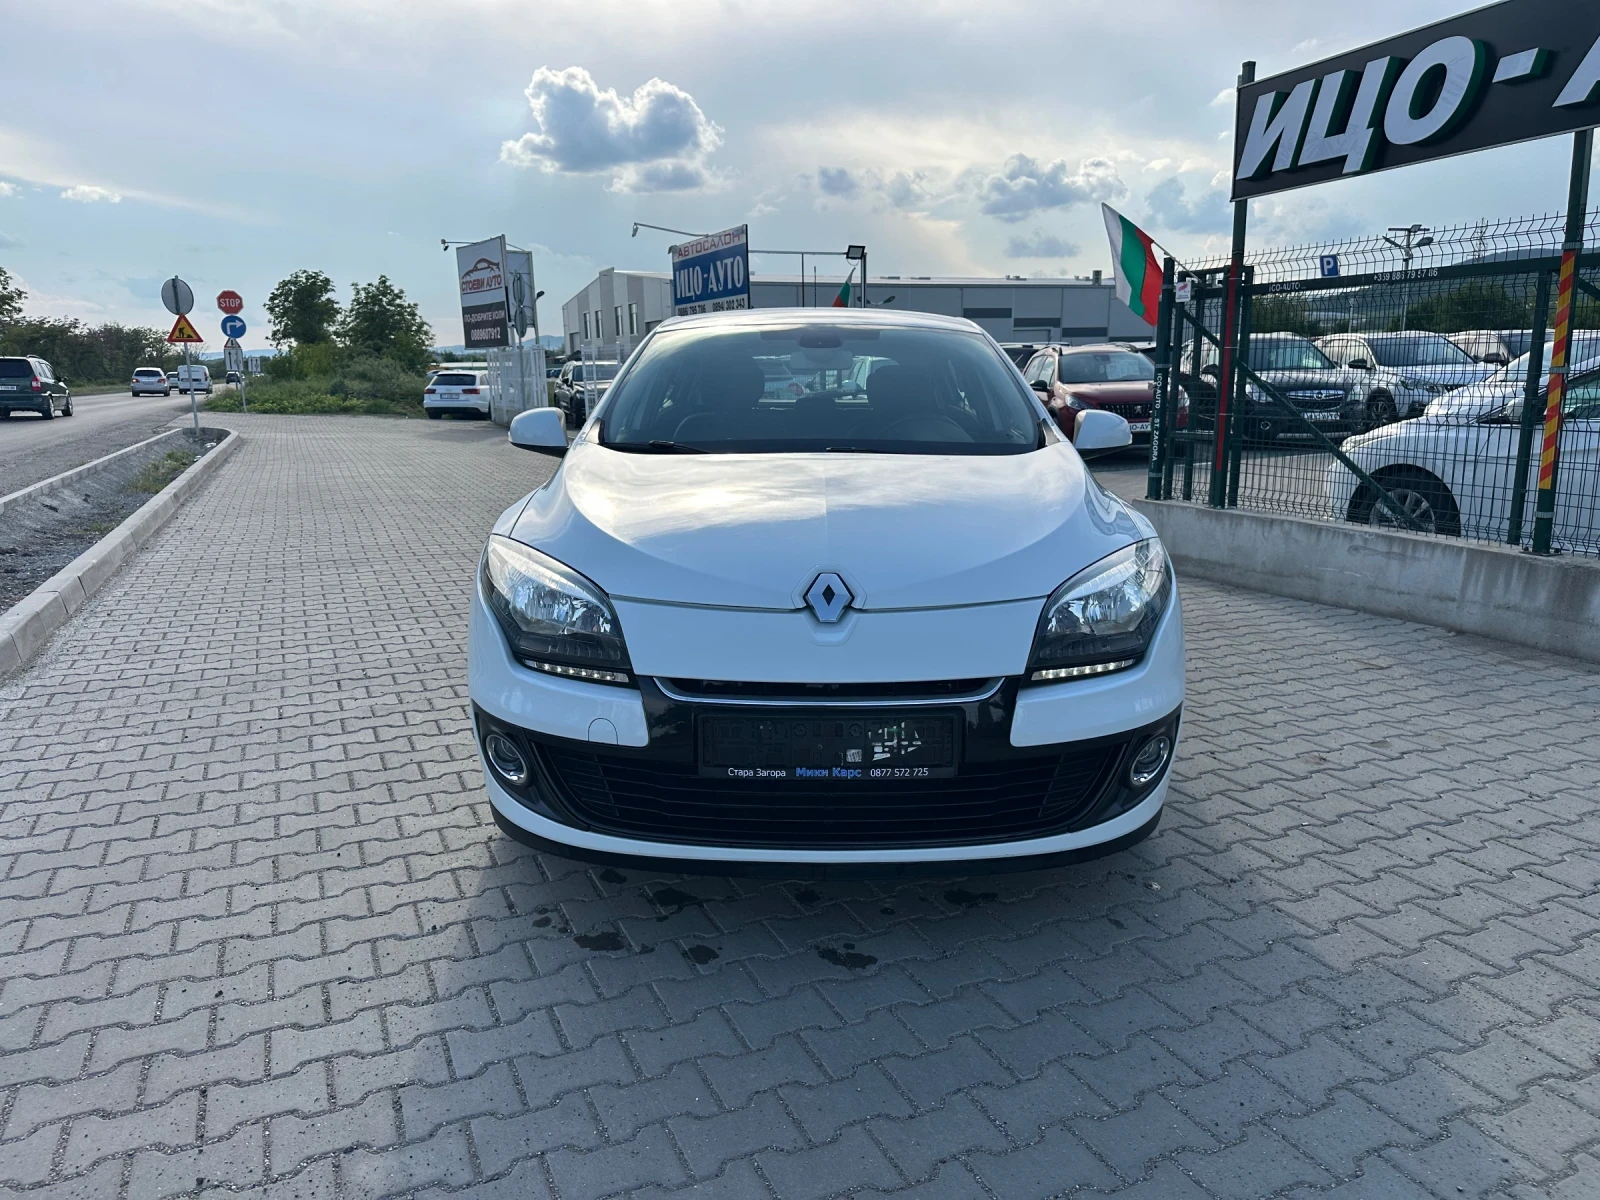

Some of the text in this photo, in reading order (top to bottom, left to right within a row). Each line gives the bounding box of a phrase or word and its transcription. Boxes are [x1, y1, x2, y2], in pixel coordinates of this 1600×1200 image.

[678, 231, 740, 259] АВТОСАЛОН
[675, 255, 744, 300] ИЦО-АУТО
[1323, 257, 1335, 275] P
[219, 298, 241, 308] STOP
[1151, 430, 1159, 462] ZAGORA
[728, 767, 929, 779] Стара Загора Мики Карс 0877 572 725
